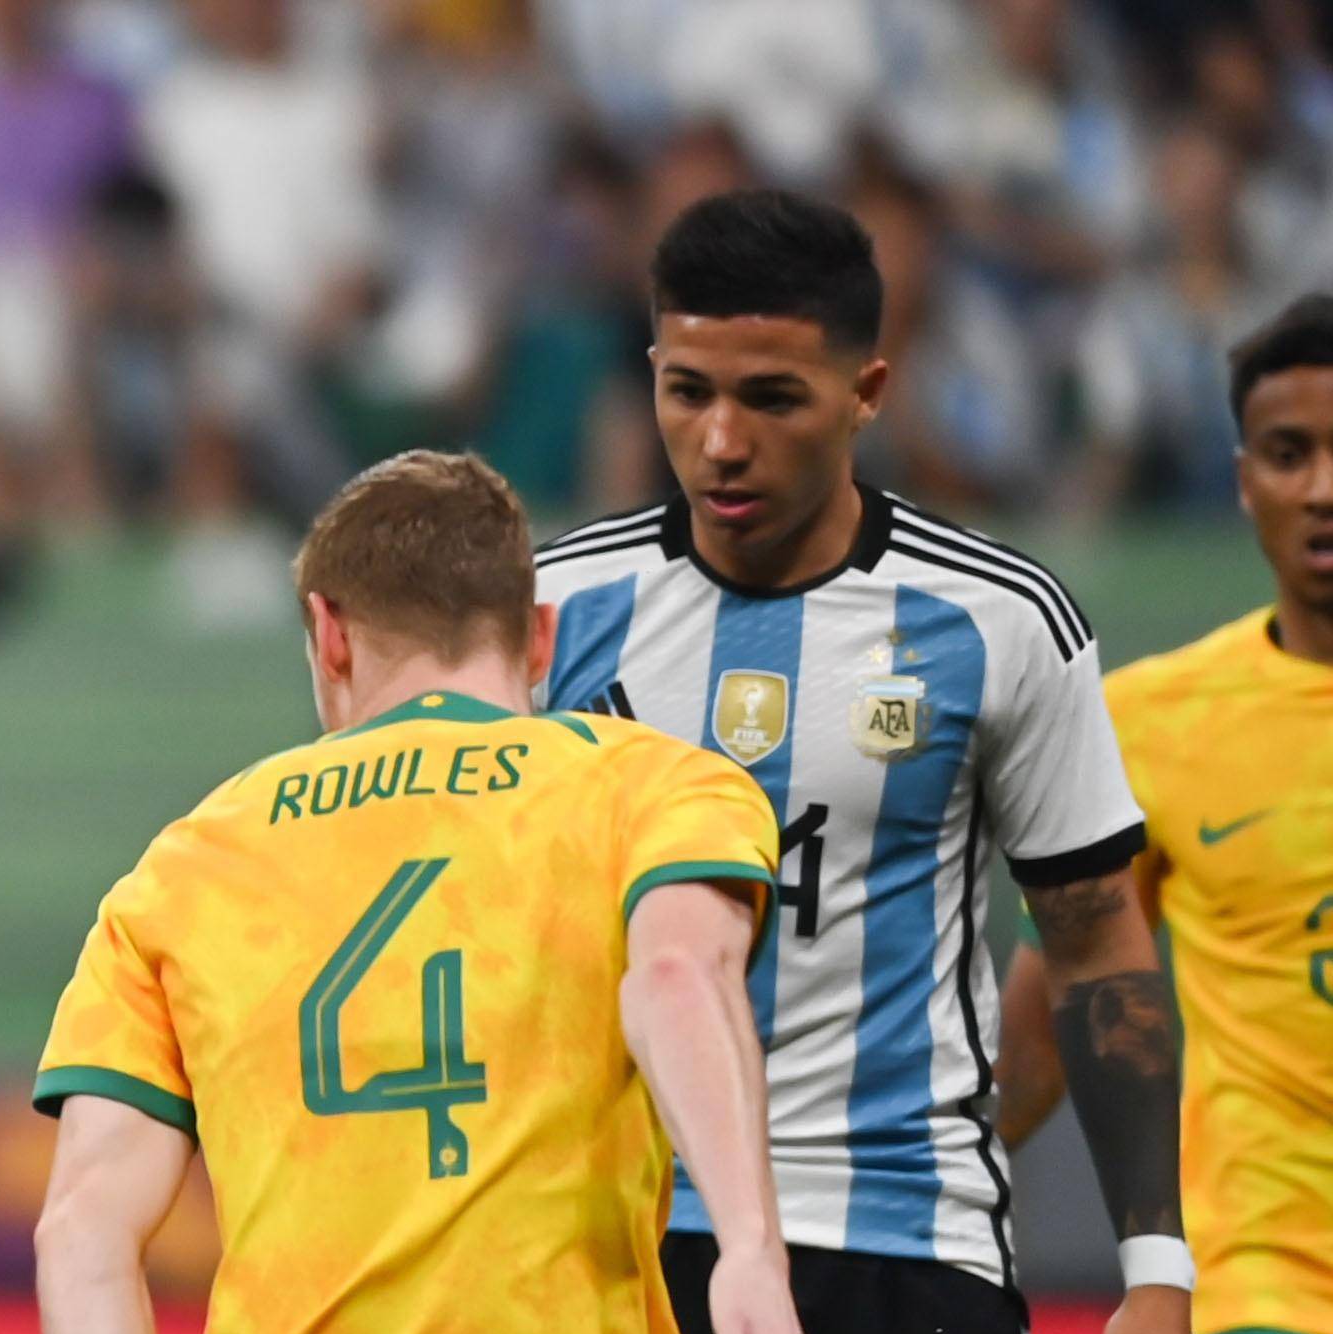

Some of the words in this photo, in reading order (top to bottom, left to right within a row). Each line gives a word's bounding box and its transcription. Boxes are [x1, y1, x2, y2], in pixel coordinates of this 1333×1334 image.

[868, 698, 911, 739] AFA
[268, 744, 529, 825] ROWLES
[298, 857, 487, 1180] 4
